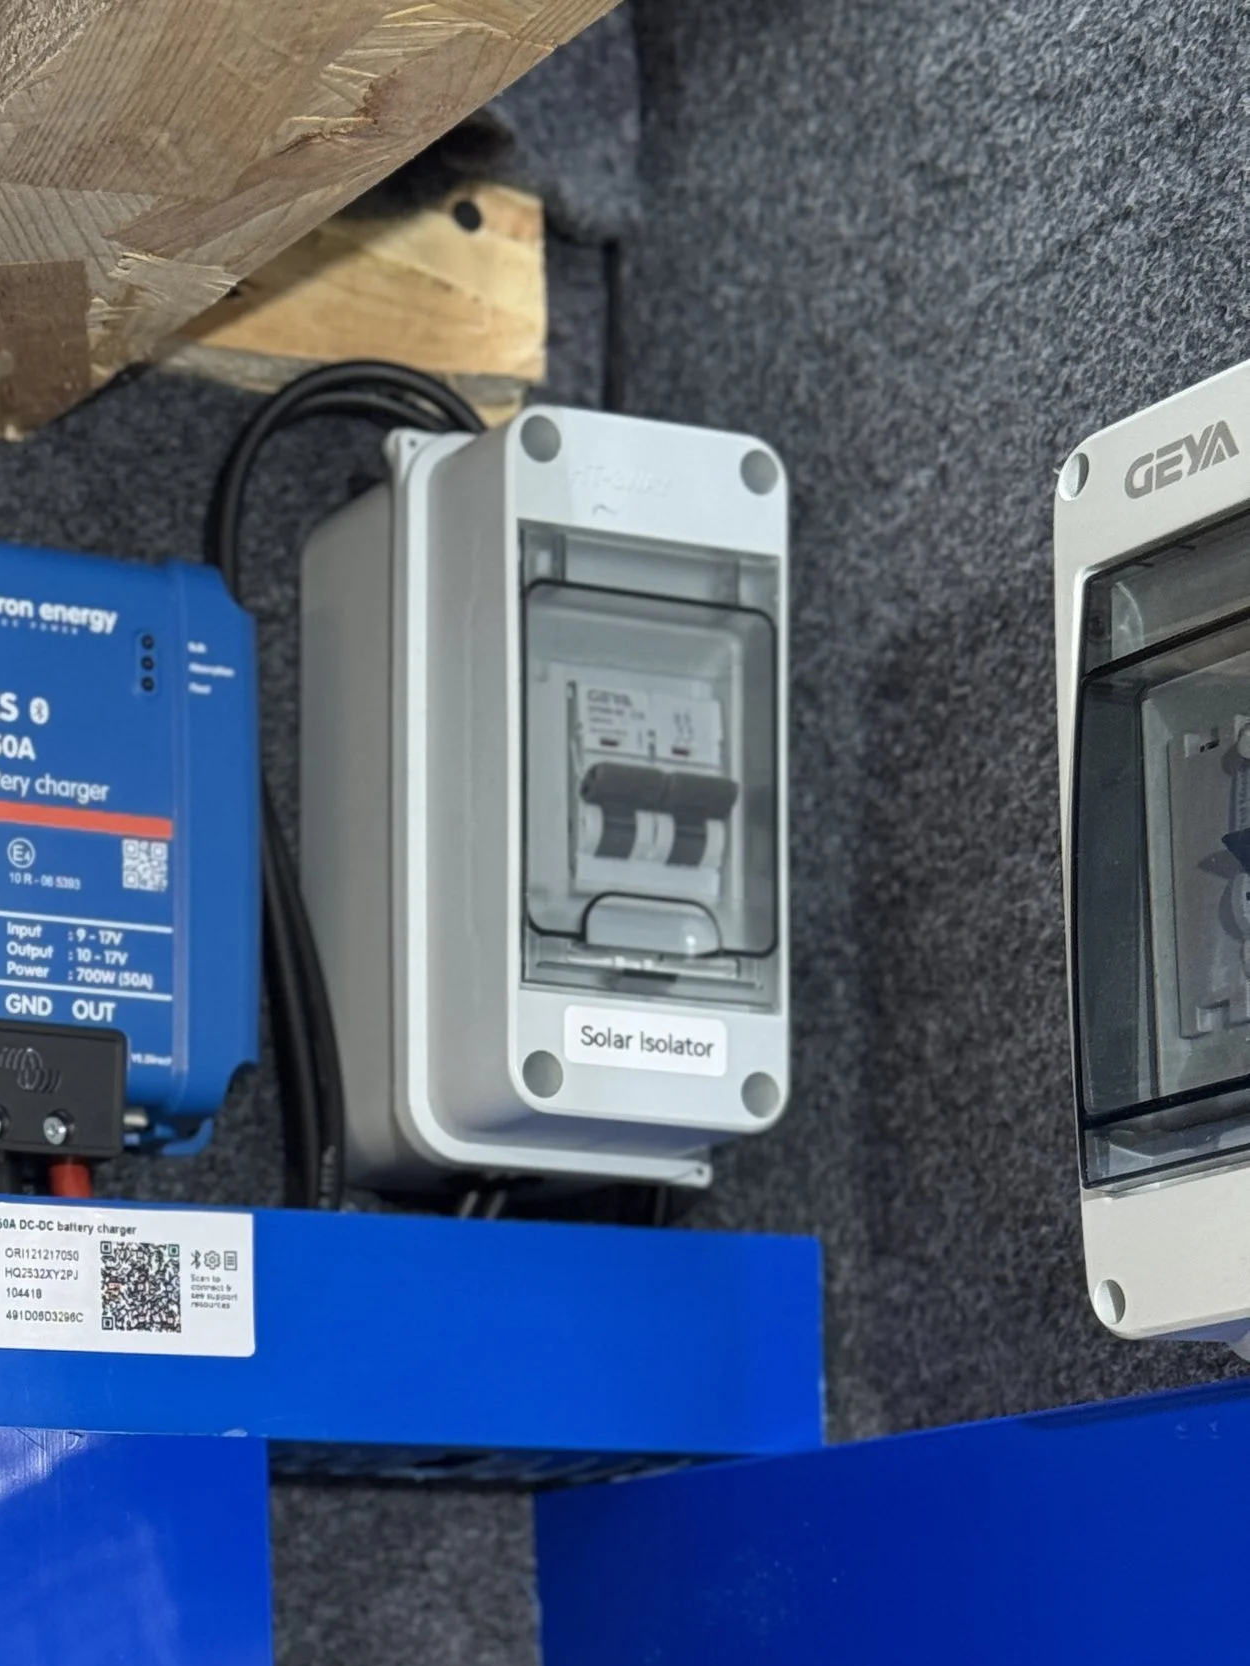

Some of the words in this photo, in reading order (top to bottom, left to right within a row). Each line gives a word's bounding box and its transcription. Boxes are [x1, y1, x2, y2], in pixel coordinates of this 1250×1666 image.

[1124, 419, 1240, 500] GEYA
[39, 601, 118, 633] energy
[35, 773, 109, 805] charger
[7, 922, 41, 943] Input
[76, 929, 85, 943] 9
[99, 931, 123, 946] 17V
[6, 941, 54, 961] Output
[76, 948, 91, 963] 10
[104, 950, 128, 966] 17V
[7, 961, 49, 979] Power
[76, 968, 116, 986] 700W
[5, 994, 53, 1017] GND
[72, 1001, 116, 1022] OUT
[580, 1026, 633, 1053] Solar
[640, 1030, 715, 1060] Isolator
[19, 1219, 54, 1233] DC-DC
[57, 1221, 93, 1237] battery
[97, 1222, 137, 1238] charger
